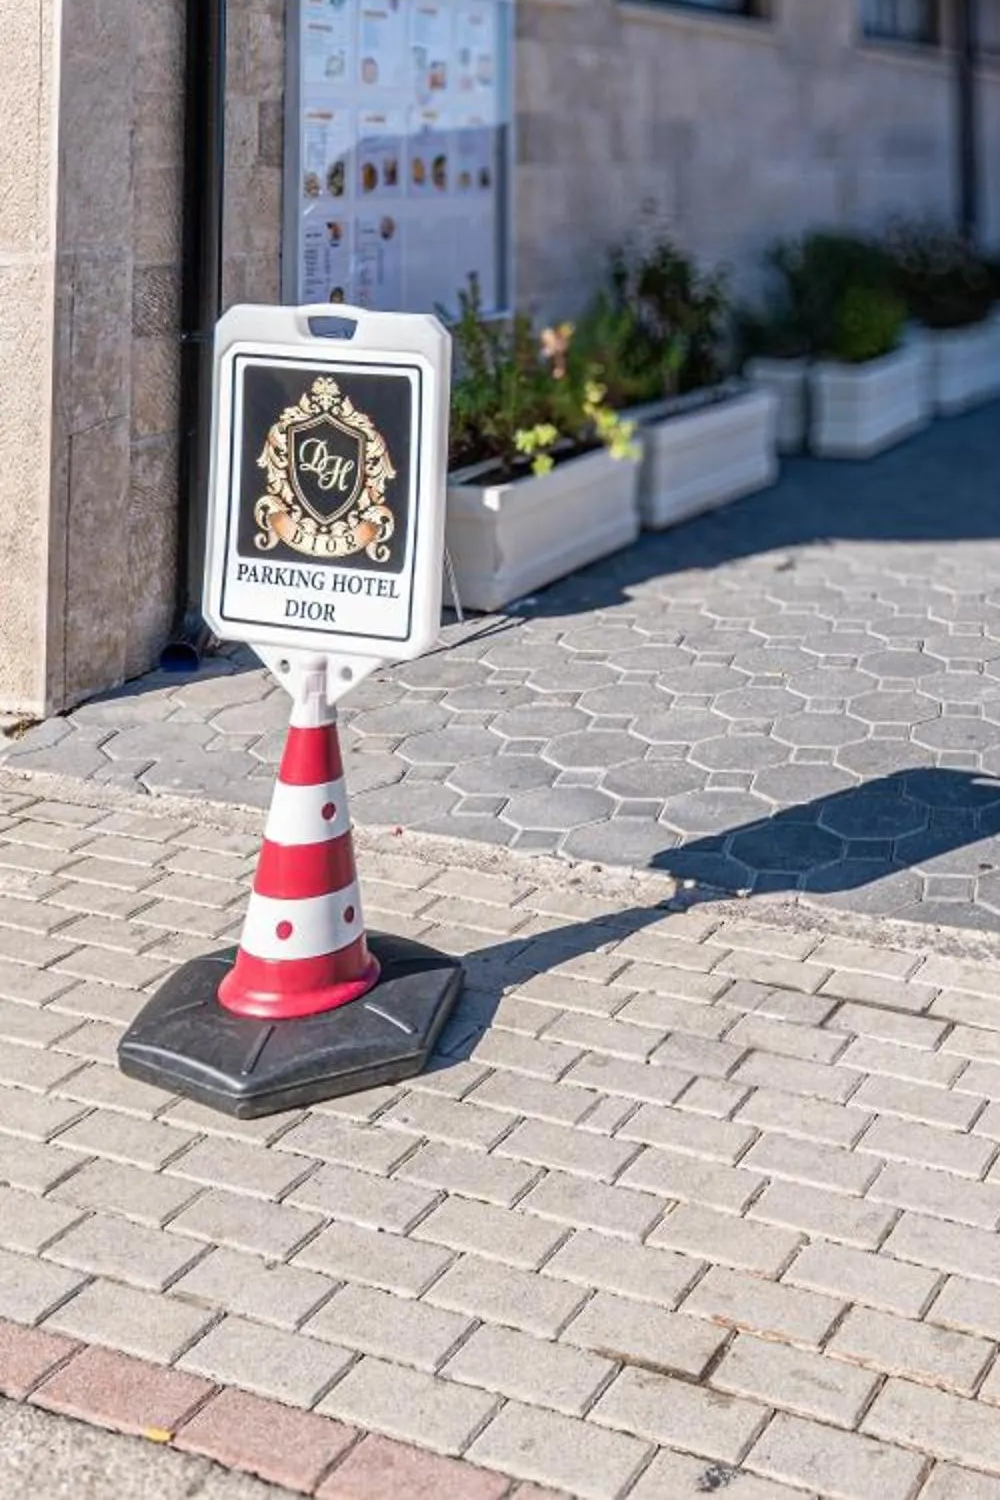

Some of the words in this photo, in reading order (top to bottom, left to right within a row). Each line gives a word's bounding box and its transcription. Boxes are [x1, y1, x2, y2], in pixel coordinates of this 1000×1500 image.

[292, 528, 357, 552] DIOR
[236, 563, 325, 591] PARKING
[332, 573, 400, 599] HOTEL
[284, 599, 336, 622] DIOR
